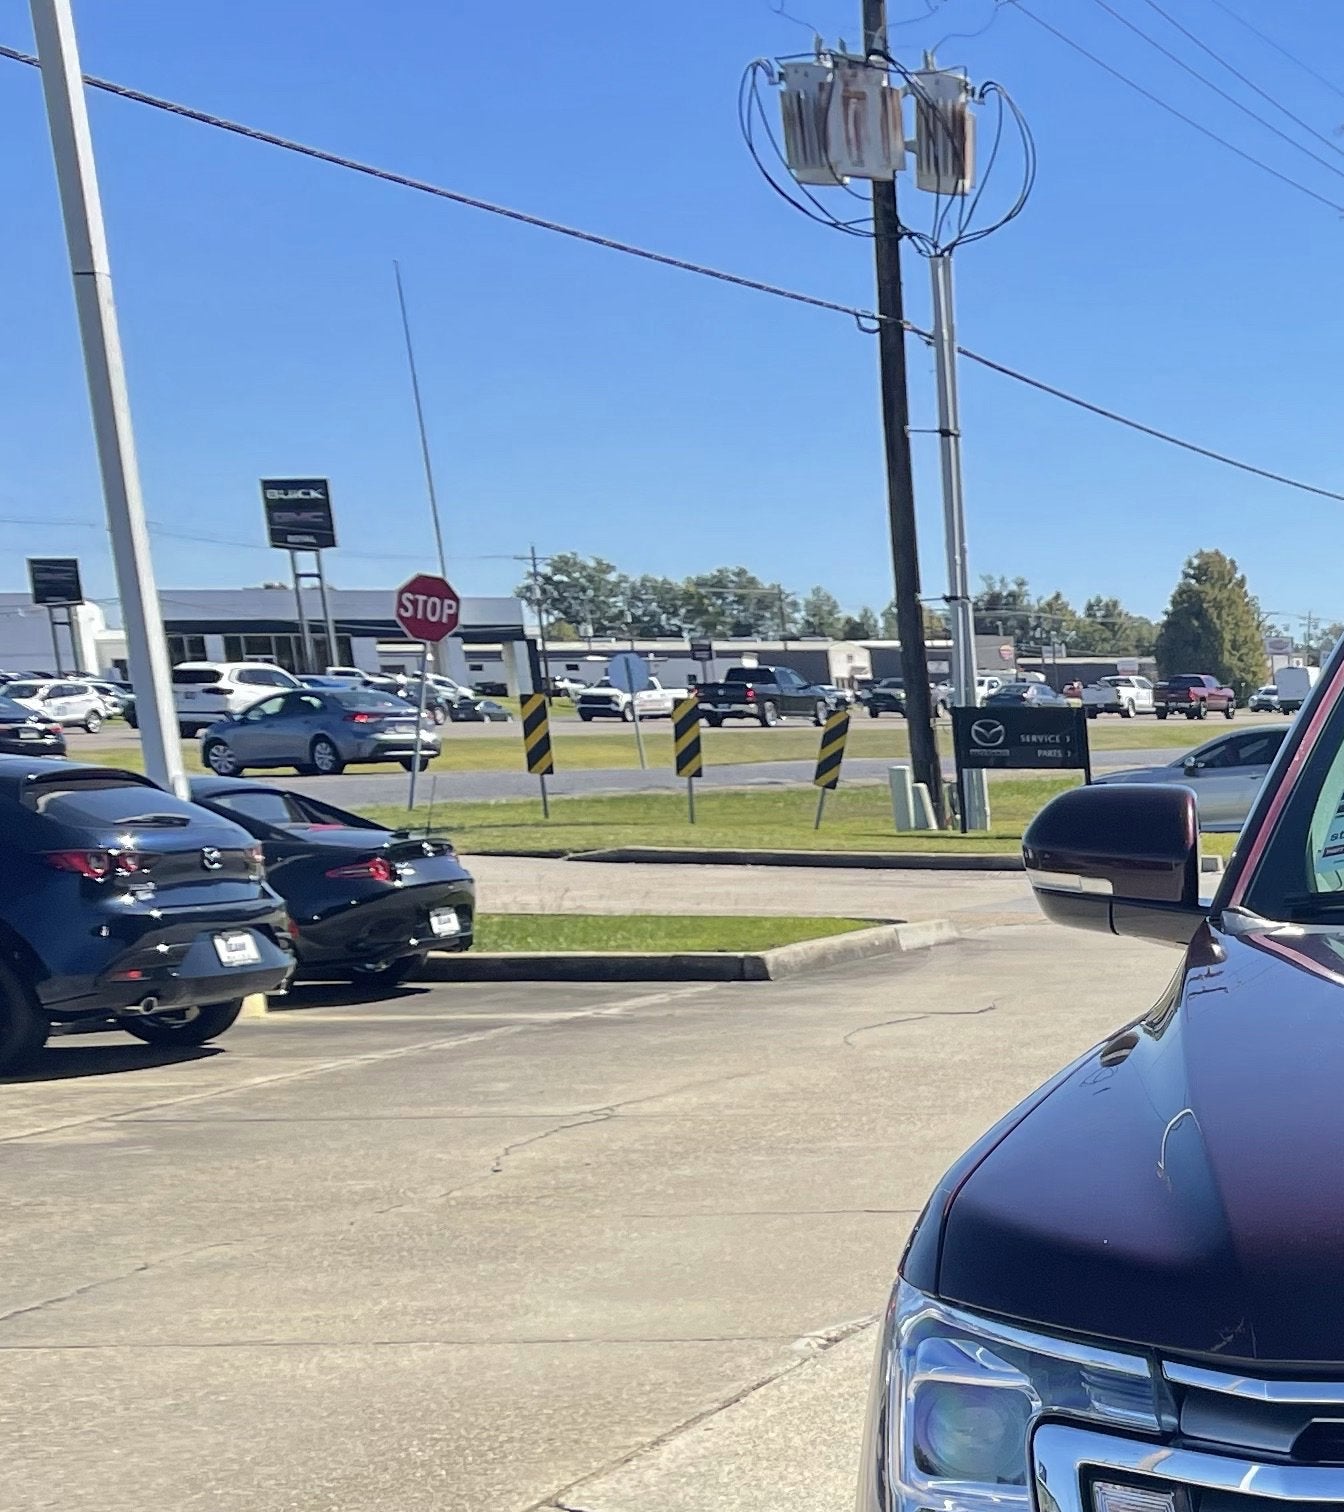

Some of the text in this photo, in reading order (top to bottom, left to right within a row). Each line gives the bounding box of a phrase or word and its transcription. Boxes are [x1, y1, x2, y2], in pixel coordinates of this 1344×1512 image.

[265, 489, 326, 499] BUICK
[399, 592, 457, 624] STOP
[1019, 734, 1061, 743] SERVICE
[1037, 748, 1063, 758] PARTS
